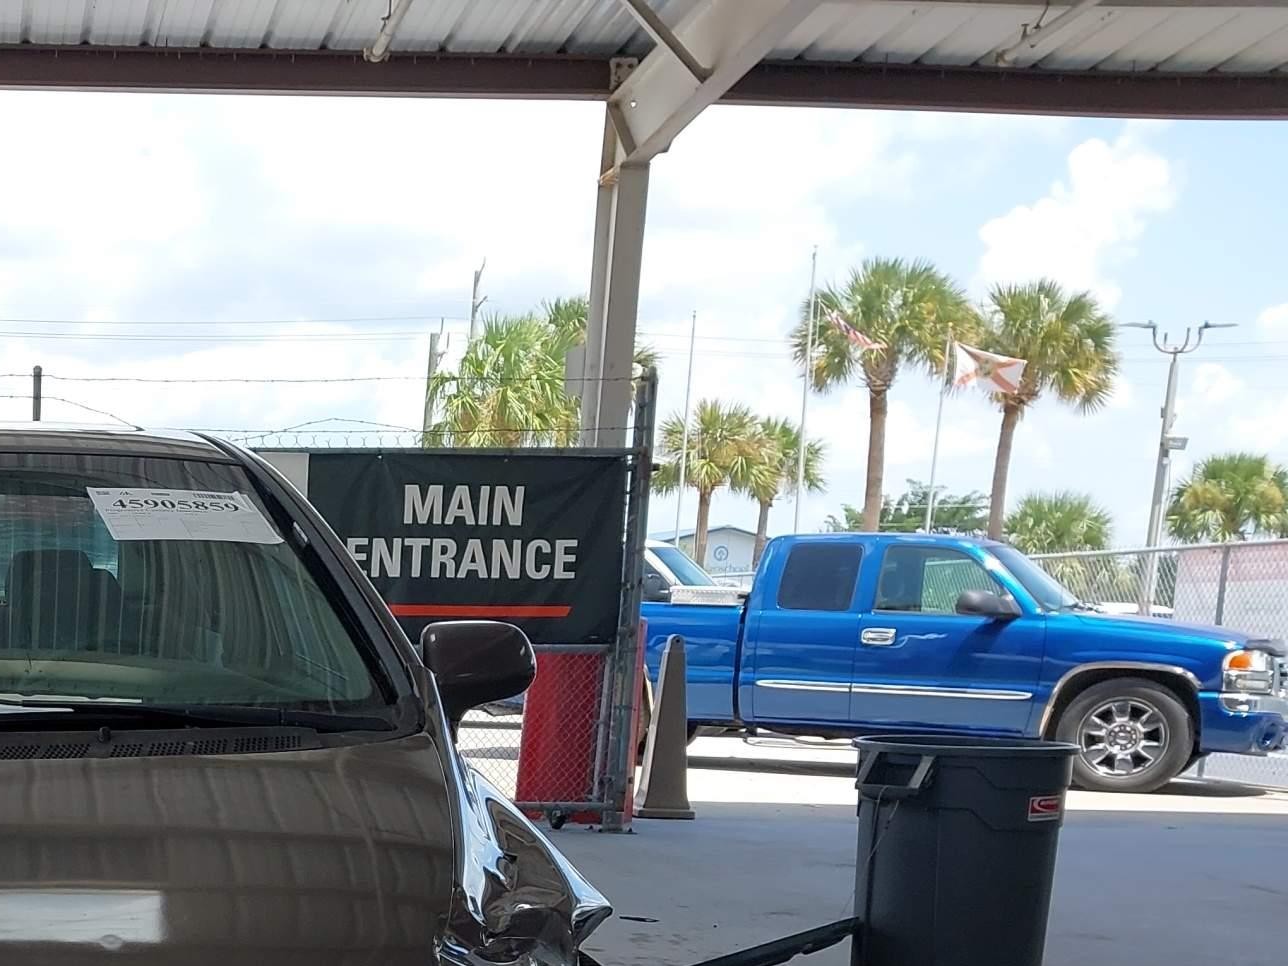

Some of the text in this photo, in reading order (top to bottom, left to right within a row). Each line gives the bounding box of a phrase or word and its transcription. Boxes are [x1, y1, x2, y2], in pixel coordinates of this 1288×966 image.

[112, 498, 240, 512] 45905859
[403, 484, 525, 526] MAIN
[346, 537, 579, 580] ENTRANCE
